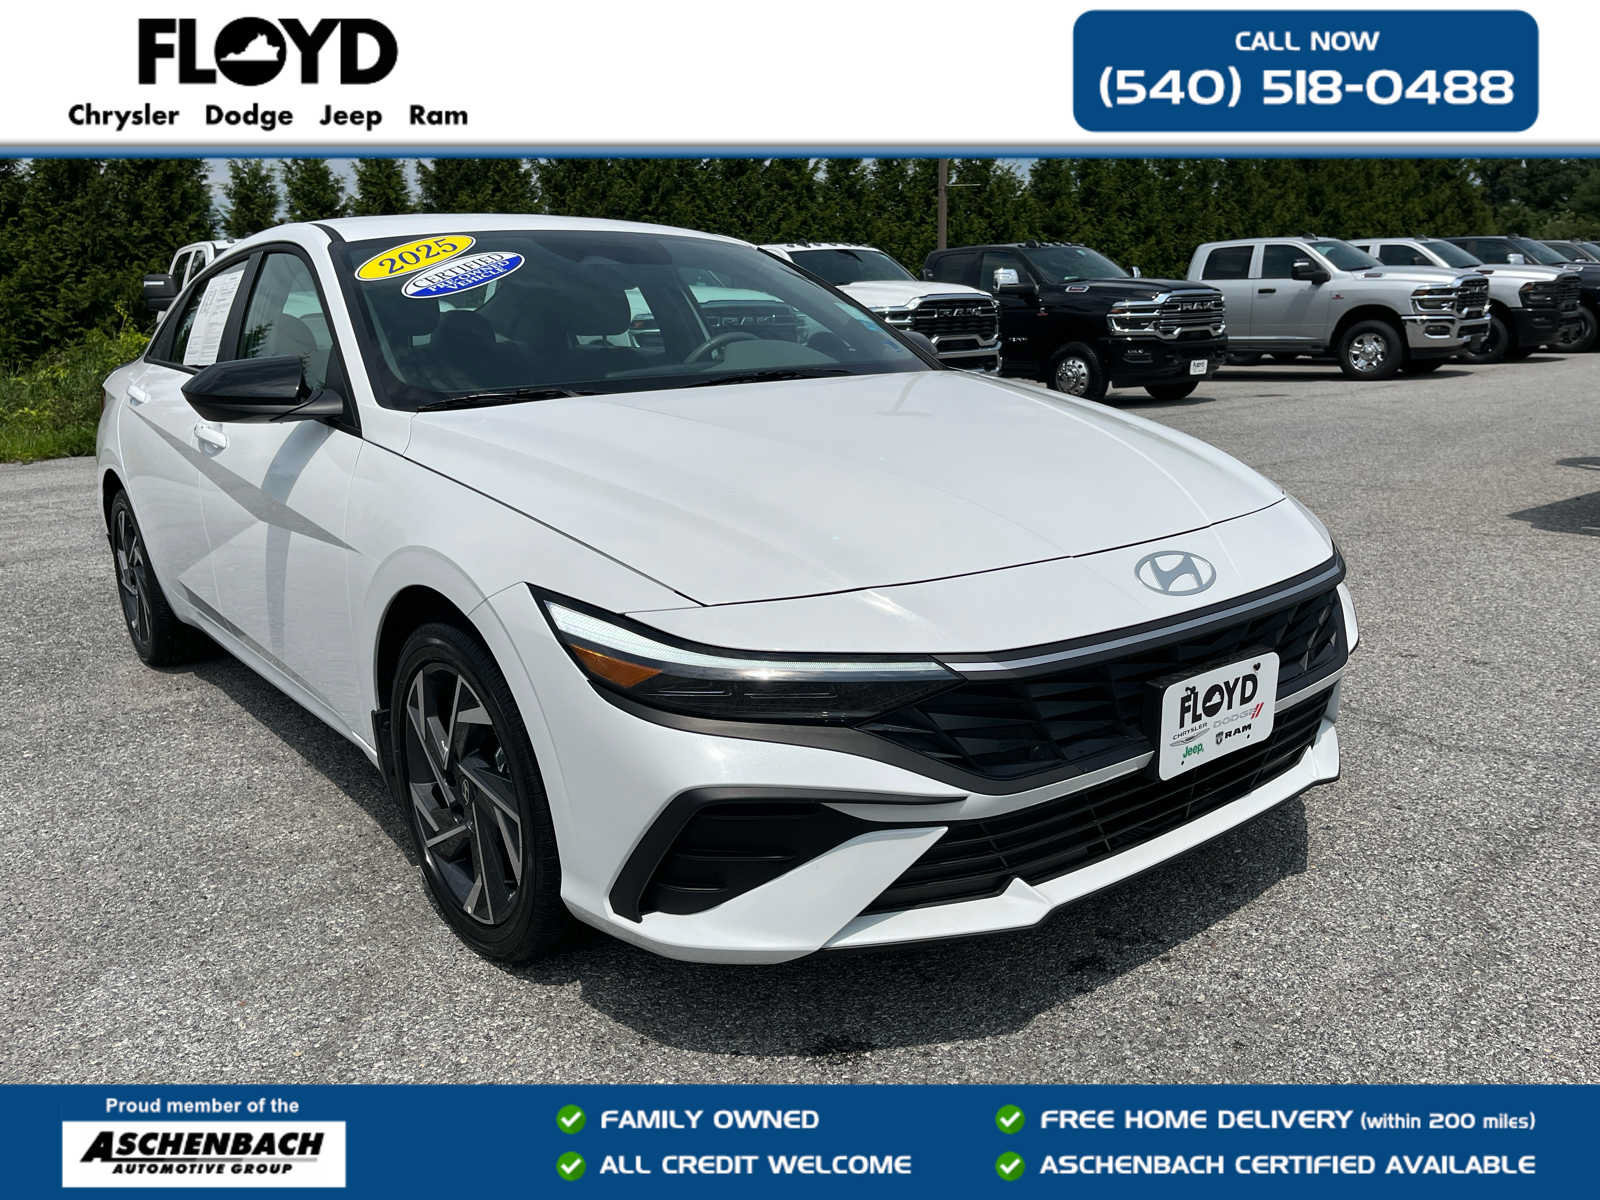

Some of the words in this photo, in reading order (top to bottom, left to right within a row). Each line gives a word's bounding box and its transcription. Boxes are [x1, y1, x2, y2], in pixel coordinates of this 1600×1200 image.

[379, 238, 458, 274] 2025
[413, 253, 504, 289] CERTIFIED
[447, 268, 508, 290] VEHICLE
[1179, 673, 1258, 729] FLOYD
[1172, 722, 1208, 740] CHRYSLER
[1224, 723, 1252, 739] RAM
[1182, 743, 1204, 758] Jeep
